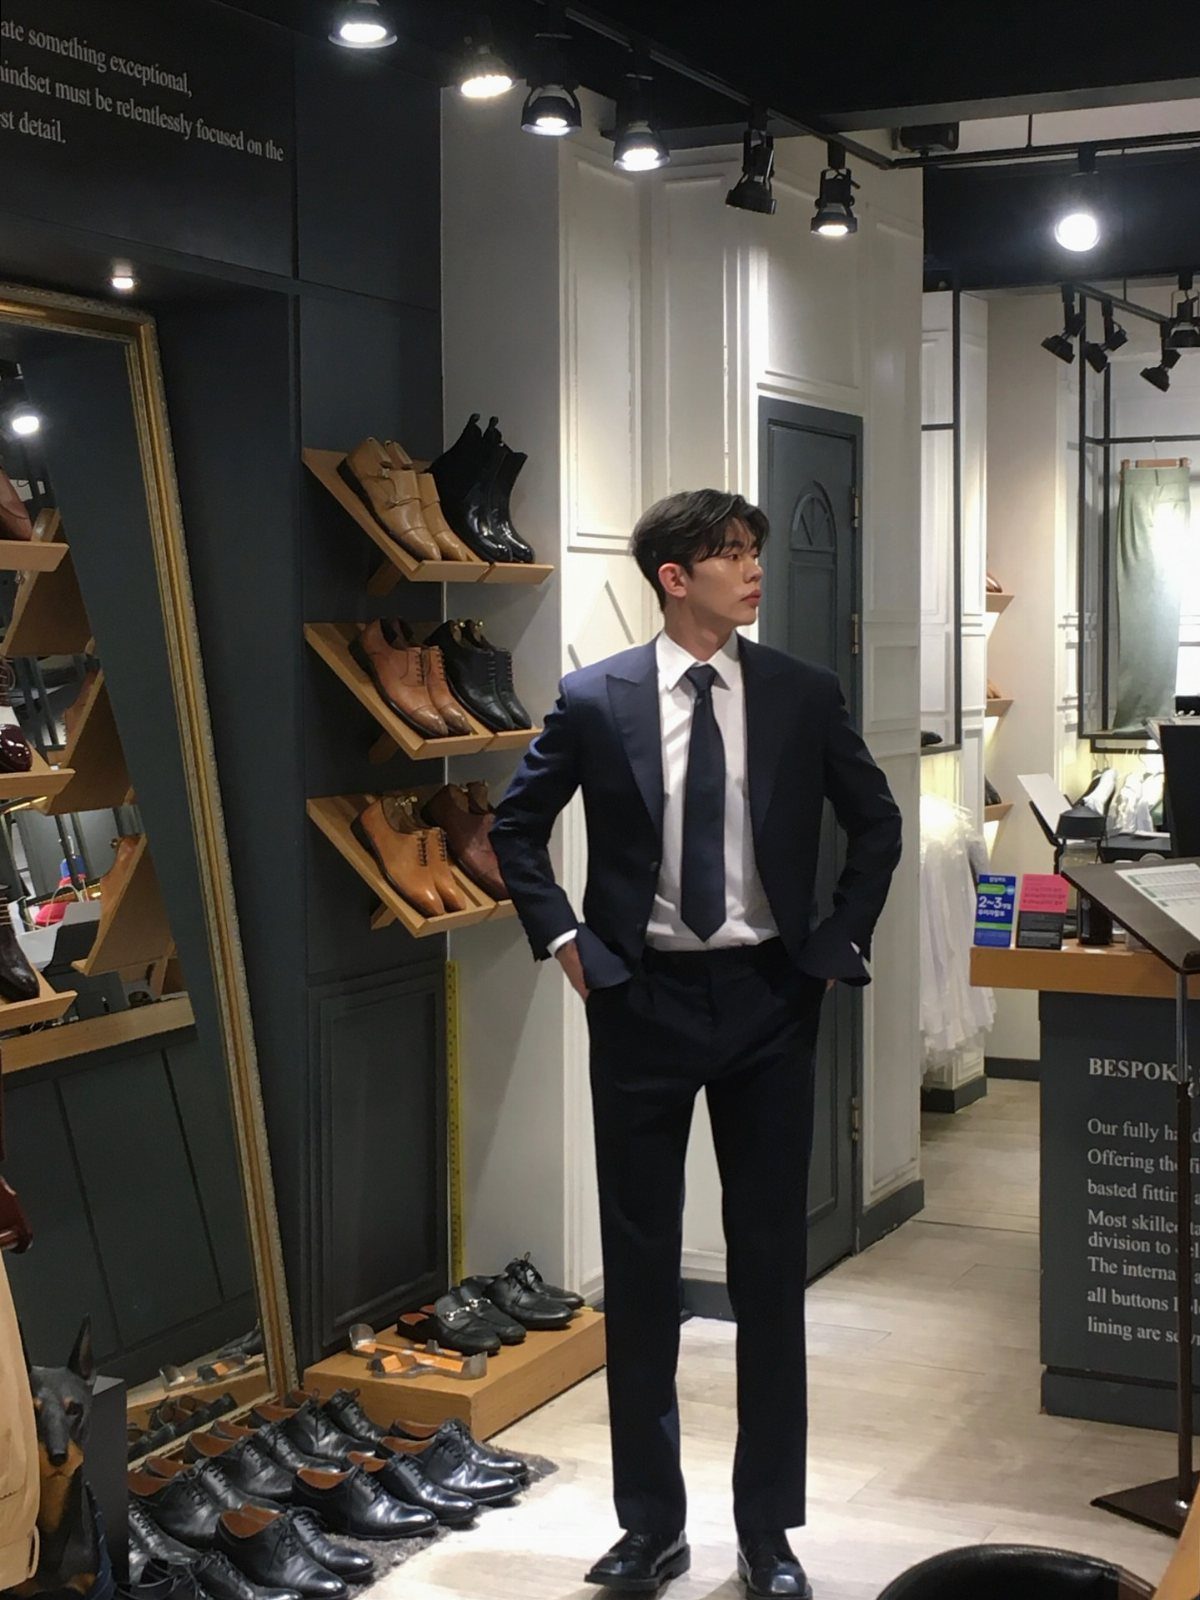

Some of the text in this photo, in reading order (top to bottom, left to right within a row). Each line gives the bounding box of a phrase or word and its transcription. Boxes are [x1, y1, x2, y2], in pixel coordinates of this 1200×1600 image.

[1, 20, 192, 98] ate something exceptional,
[0, 111, 66, 144] st detail.
[55, 82, 92, 107] must
[95, 87, 113, 112] be
[116, 98, 192, 140] relentlessly
[195, 118, 244, 150] focused
[247, 139, 262, 156] on
[265, 140, 284, 161] the
[1089, 1057, 1192, 1083] BESPOK
[1087, 1118, 1118, 1135] Our
[1123, 1121, 1159, 1143] fully
[1087, 1148, 1155, 1174] Offering
[1087, 1179, 1137, 1199] basted
[1142, 1184, 1178, 1203] fittin
[1087, 1209, 1128, 1228] Most
[1087, 1231, 1151, 1253] division
[1155, 1240, 1171, 1255] to
[1087, 1256, 1118, 1274] The
[1122, 1259, 1177, 1281] interna
[1087, 1286, 1107, 1304] all
[1111, 1288, 1169, 1312] buttons
[1087, 1316, 1133, 1341] lining
[1137, 1326, 1161, 1341] are
